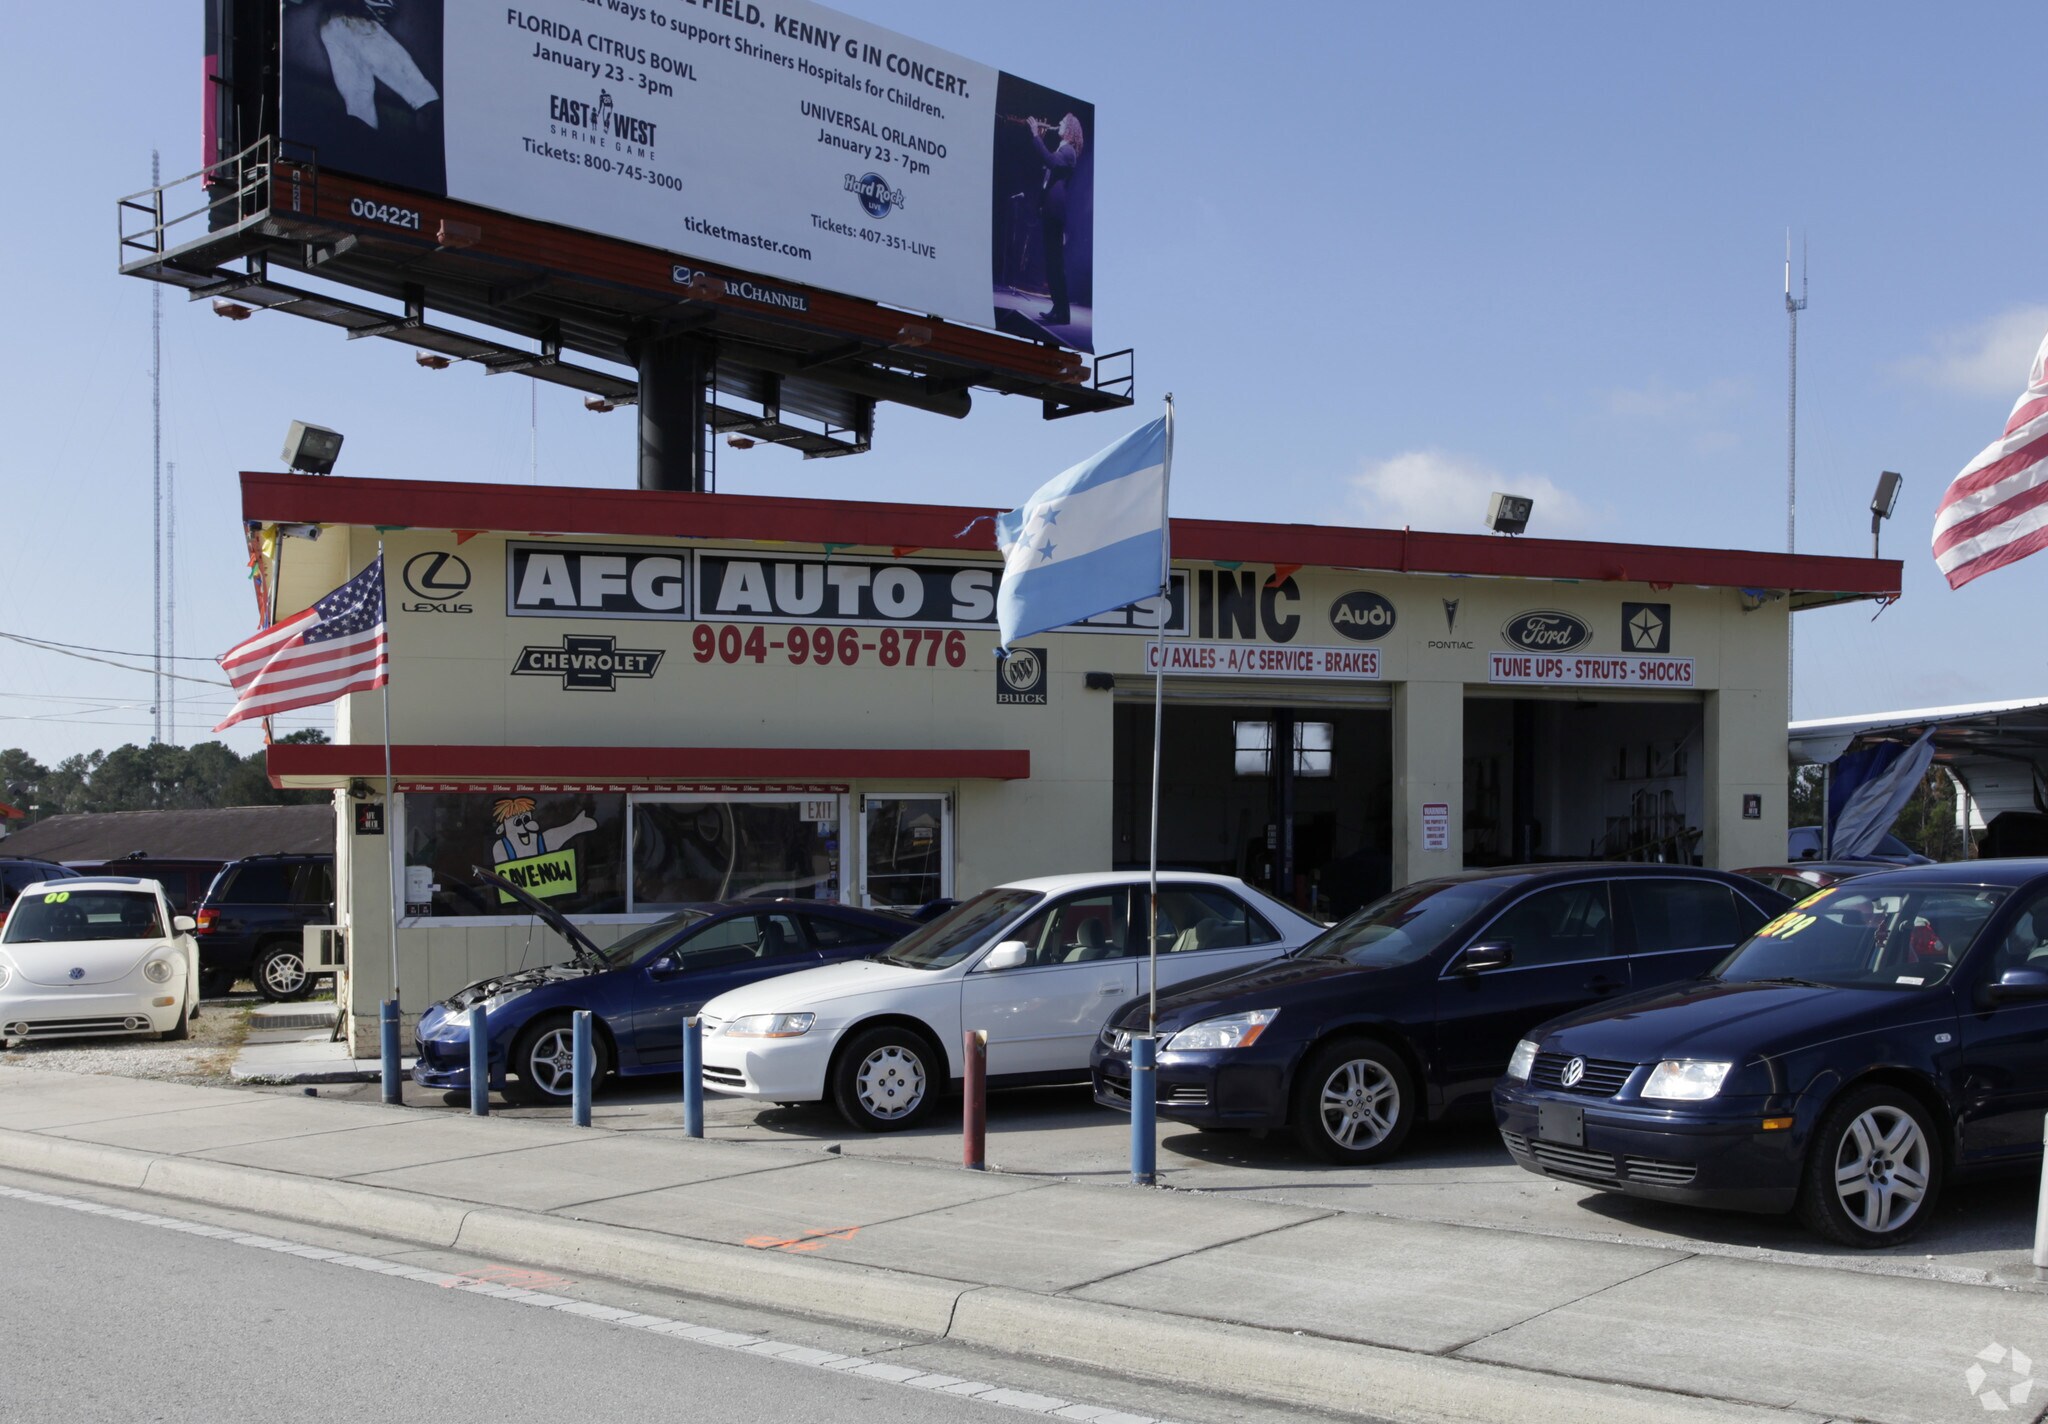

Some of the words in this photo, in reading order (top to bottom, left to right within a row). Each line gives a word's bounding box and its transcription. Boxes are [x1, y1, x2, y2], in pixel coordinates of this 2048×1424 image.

[507, 8, 583, 46] FLORIDA
[588, 34, 646, 65] CITRUS
[651, 52, 697, 82] BOWL
[607, 0, 646, 21] ways
[650, 10, 666, 27] to
[670, 18, 731, 49] support
[735, 37, 794, 69] Shriners
[798, 57, 862, 91] Hospitals
[865, 79, 884, 98] for
[887, 88, 945, 119] Children.
[774, 13, 840, 52] KENNY
[845, 40, 857, 58] G
[862, 44, 881, 67] IN
[886, 54, 969, 98] CONCERT.
[533, 42, 601, 79] January
[605, 63, 624, 82] 23
[638, 73, 673, 97] 3pm
[550, 94, 590, 129] EAST
[614, 112, 657, 147] WEST
[801, 100, 878, 138] UNIVERSAL
[881, 126, 947, 159] ORLANDO
[551, 124, 605, 148] SHRINE
[616, 141, 655, 161] GAME
[818, 128, 872, 160] January
[875, 146, 891, 163] 23
[902, 154, 930, 175] 7pm
[522, 137, 580, 165] Tickets:
[584, 153, 683, 191] 800-745-3000
[844, 173, 875, 197] Hard
[876, 183, 904, 210] Rock
[868, 202, 882, 211] LIVE
[351, 198, 419, 230] 004221
[684, 216, 812, 261] ticketmaster.com
[811, 214, 857, 238] Tickets:
[859, 228, 936, 259] 407-351-LIVE
[517, 553, 682, 611] AFG
[716, 561, 924, 618] AUTO
[402, 602, 473, 613] LEXUS
[1199, 569, 1301, 643] INC
[1334, 603, 1391, 625] Audi
[692, 624, 966, 668] 904-996-8776
[1428, 641, 1474, 649] PONTIAC
[1521, 617, 1573, 645] Ford
[530, 652, 647, 671] CHEVROLET
[1172, 647, 1215, 669] AXLES
[1228, 649, 1256, 672] A/C
[1259, 650, 1313, 671] SERVICE
[1325, 652, 1377, 673] BRAKES
[1493, 657, 1531, 677] TUNE
[1536, 658, 1563, 678] UPS
[1575, 660, 1627, 680] STRUTS
[1639, 662, 1691, 681] SHOCKS
[998, 693, 1045, 703] BUICK
[808, 801, 833, 819] EXIT
